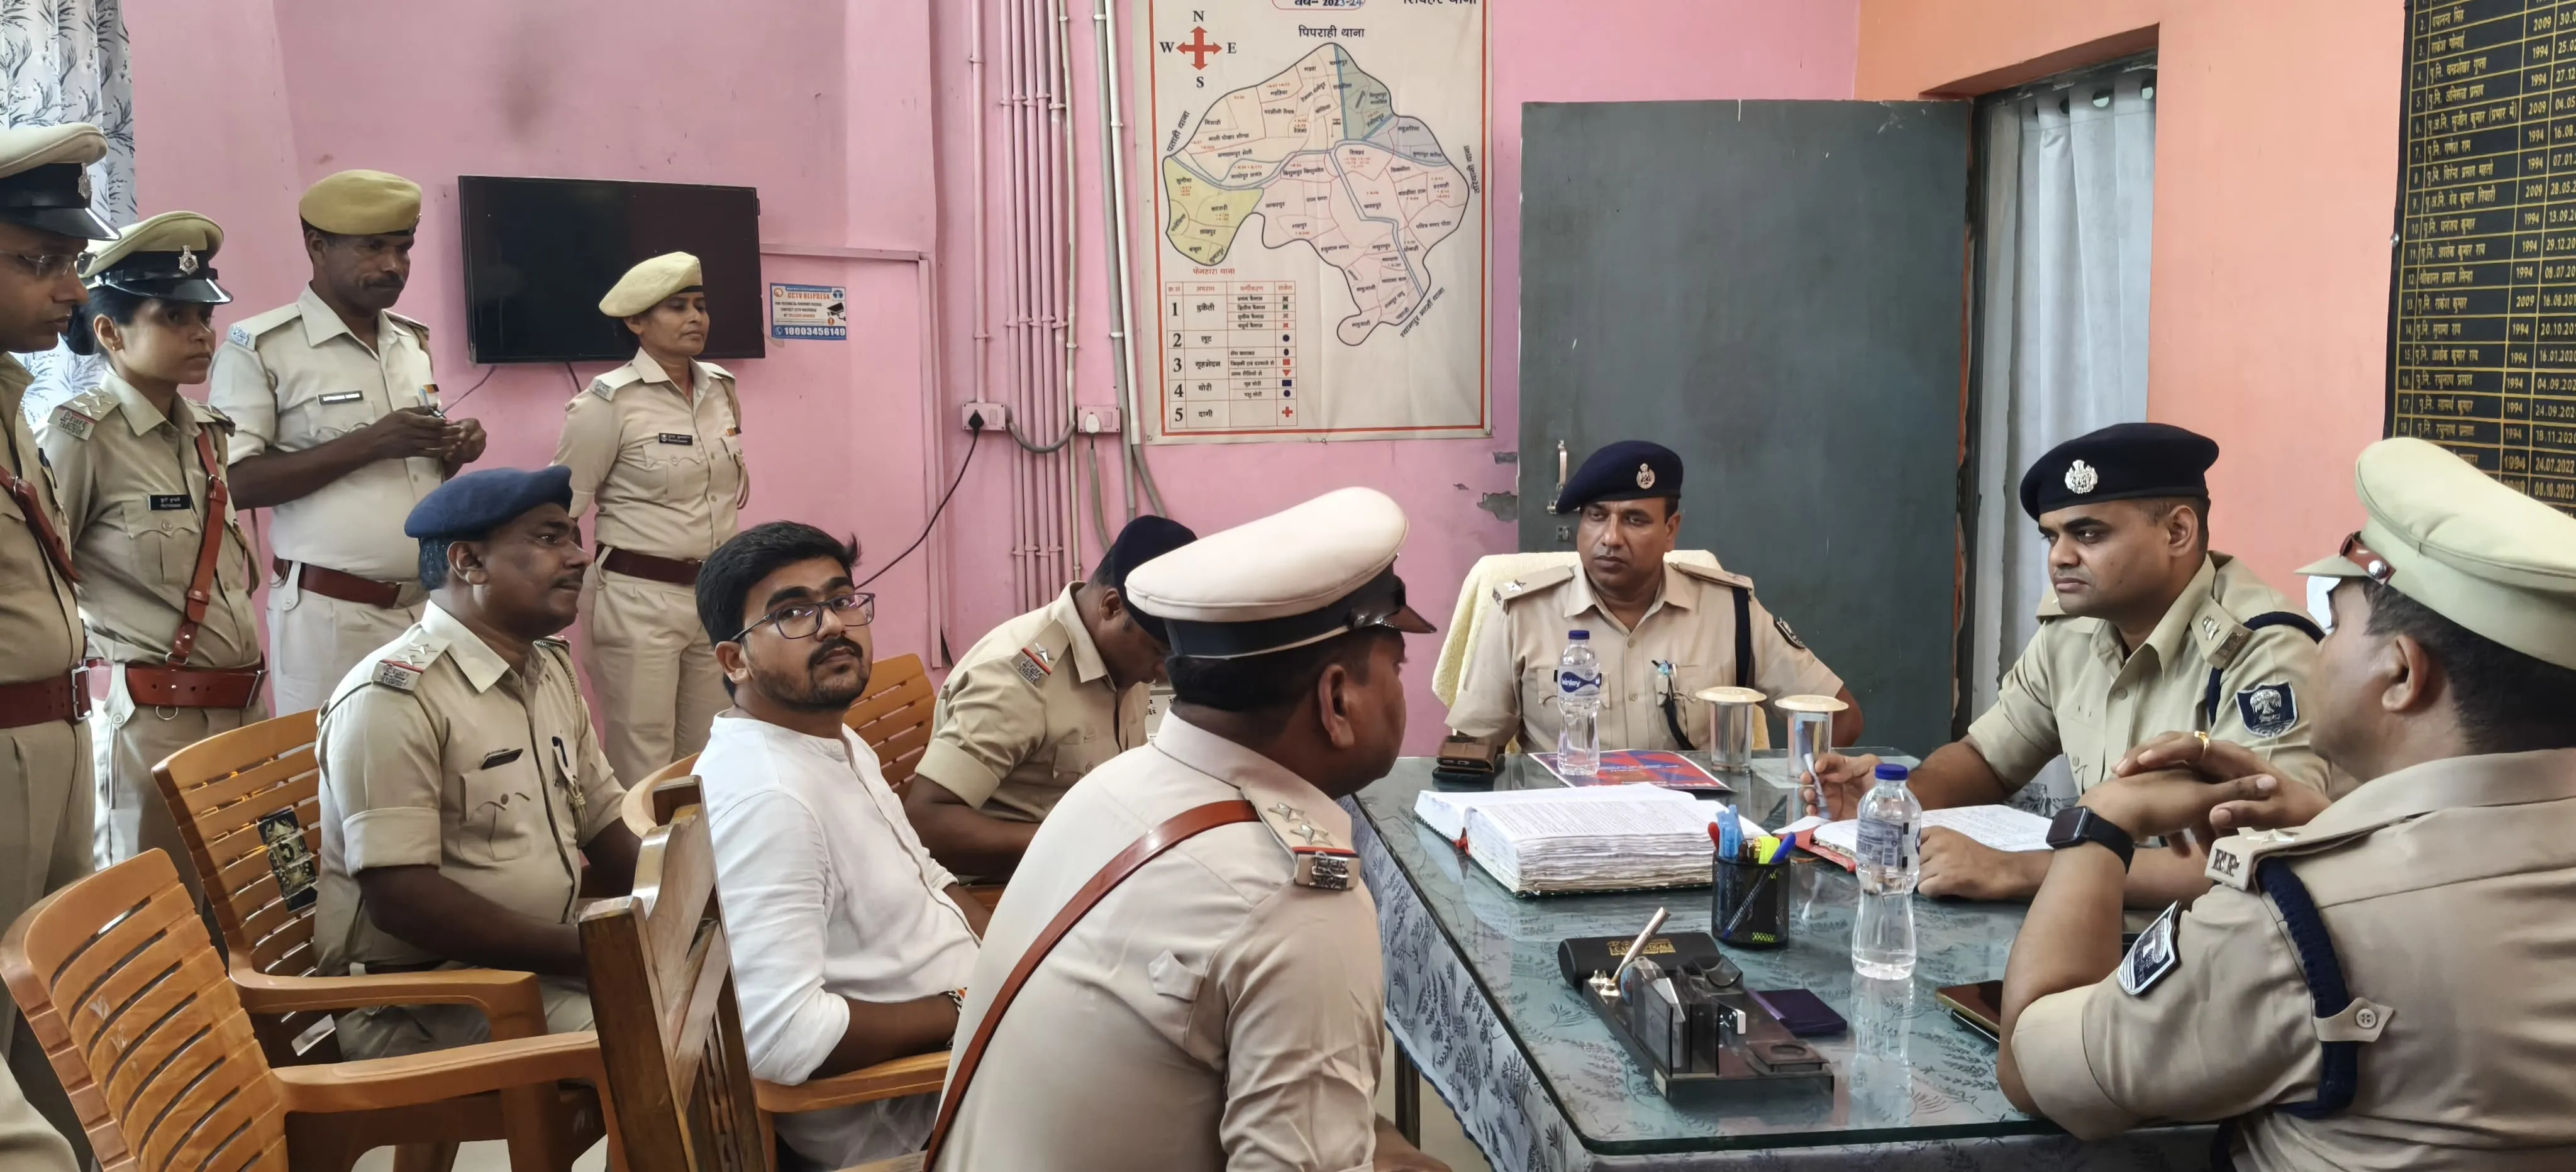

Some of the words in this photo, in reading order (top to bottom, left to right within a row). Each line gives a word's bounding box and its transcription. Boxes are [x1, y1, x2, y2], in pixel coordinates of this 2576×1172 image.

[1192, 10, 1205, 23] N
[2533, 16, 2551, 31] 2009
[1299, 25, 1336, 38] पिपराही
[1341, 28, 1365, 38] थाना
[1159, 41, 1175, 53] W
[1227, 42, 1237, 54] E
[2533, 44, 2548, 59] 1994
[1196, 76, 1204, 88] S
[2531, 72, 2546, 87] 1994
[1177, 111, 1190, 129] थाना
[2470, 111, 2485, 129] कुमार
[2529, 101, 2546, 115] 2009
[2528, 128, 2544, 143] 1994
[2528, 156, 2543, 171] 1994
[2460, 192, 2475, 209] कुमार
[2526, 184, 2542, 197] 2009
[2524, 213, 2540, 226] 1994
[2458, 245, 2472, 262] कुमार
[2523, 240, 2538, 253] 1994
[2516, 266, 2533, 279] 1994
[1433, 287, 1445, 301] थाना
[1172, 302, 1179, 316] 1
[2453, 297, 2467, 314] कुमार
[2516, 295, 2534, 307] 2009
[2512, 323, 2529, 336] 1994
[1173, 333, 1182, 347] 2
[1201, 336, 1212, 344] लूट
[1174, 358, 1182, 372] 3
[2511, 352, 2527, 365] 1994
[1198, 383, 1212, 391] चोरी
[2507, 377, 2523, 389] 1994
[1174, 384, 1184, 397] 4
[1175, 407, 1183, 421] 5
[2506, 402, 2523, 414] 1994
[2506, 428, 2522, 440] 1994
[2535, 457, 2575, 473] 24.07.2022
